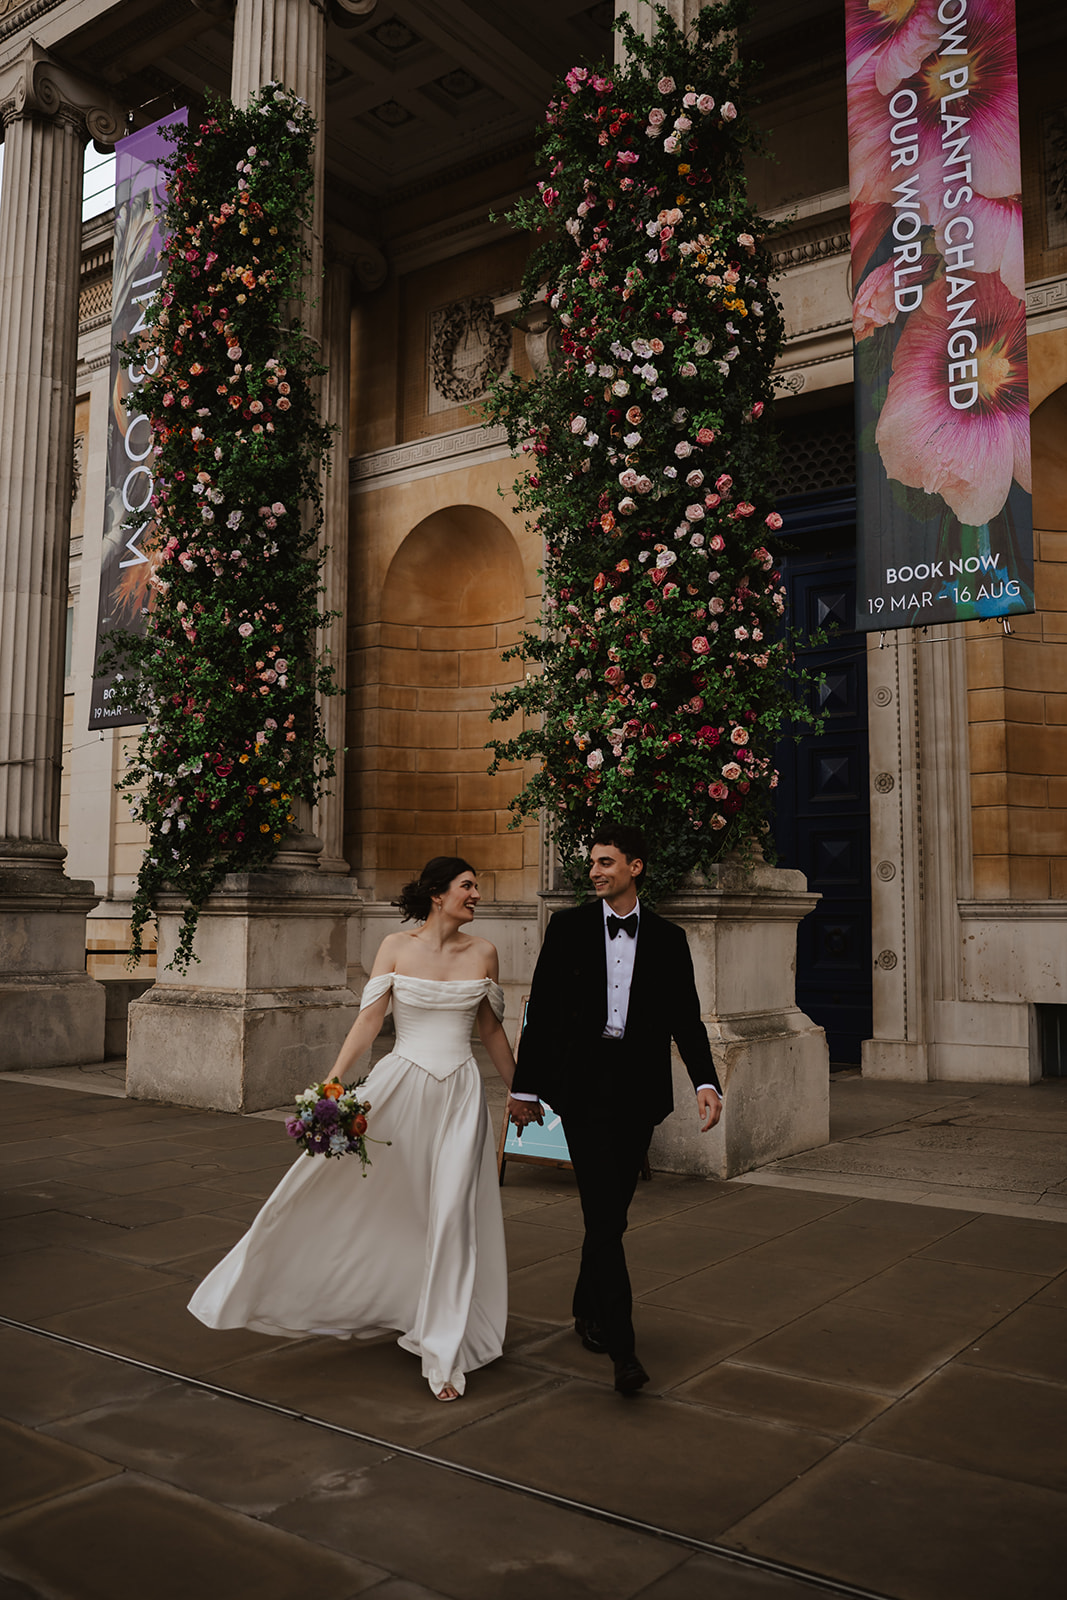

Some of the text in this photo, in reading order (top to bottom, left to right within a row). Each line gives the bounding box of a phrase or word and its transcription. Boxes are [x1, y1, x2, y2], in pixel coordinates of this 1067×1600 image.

[940, 65, 974, 209] PLANTS
[888, 88, 924, 313] OUR WORLD
[943, 220, 979, 410] CHANGED
[868, 597, 885, 615] 19
[891, 590, 933, 612] MAR
[953, 585, 972, 604] 16
[976, 579, 1021, 602] AUG
[886, 553, 1001, 585] BOOK NOW
[94, 707, 102, 719] 19
[103, 704, 122, 718] MAR
